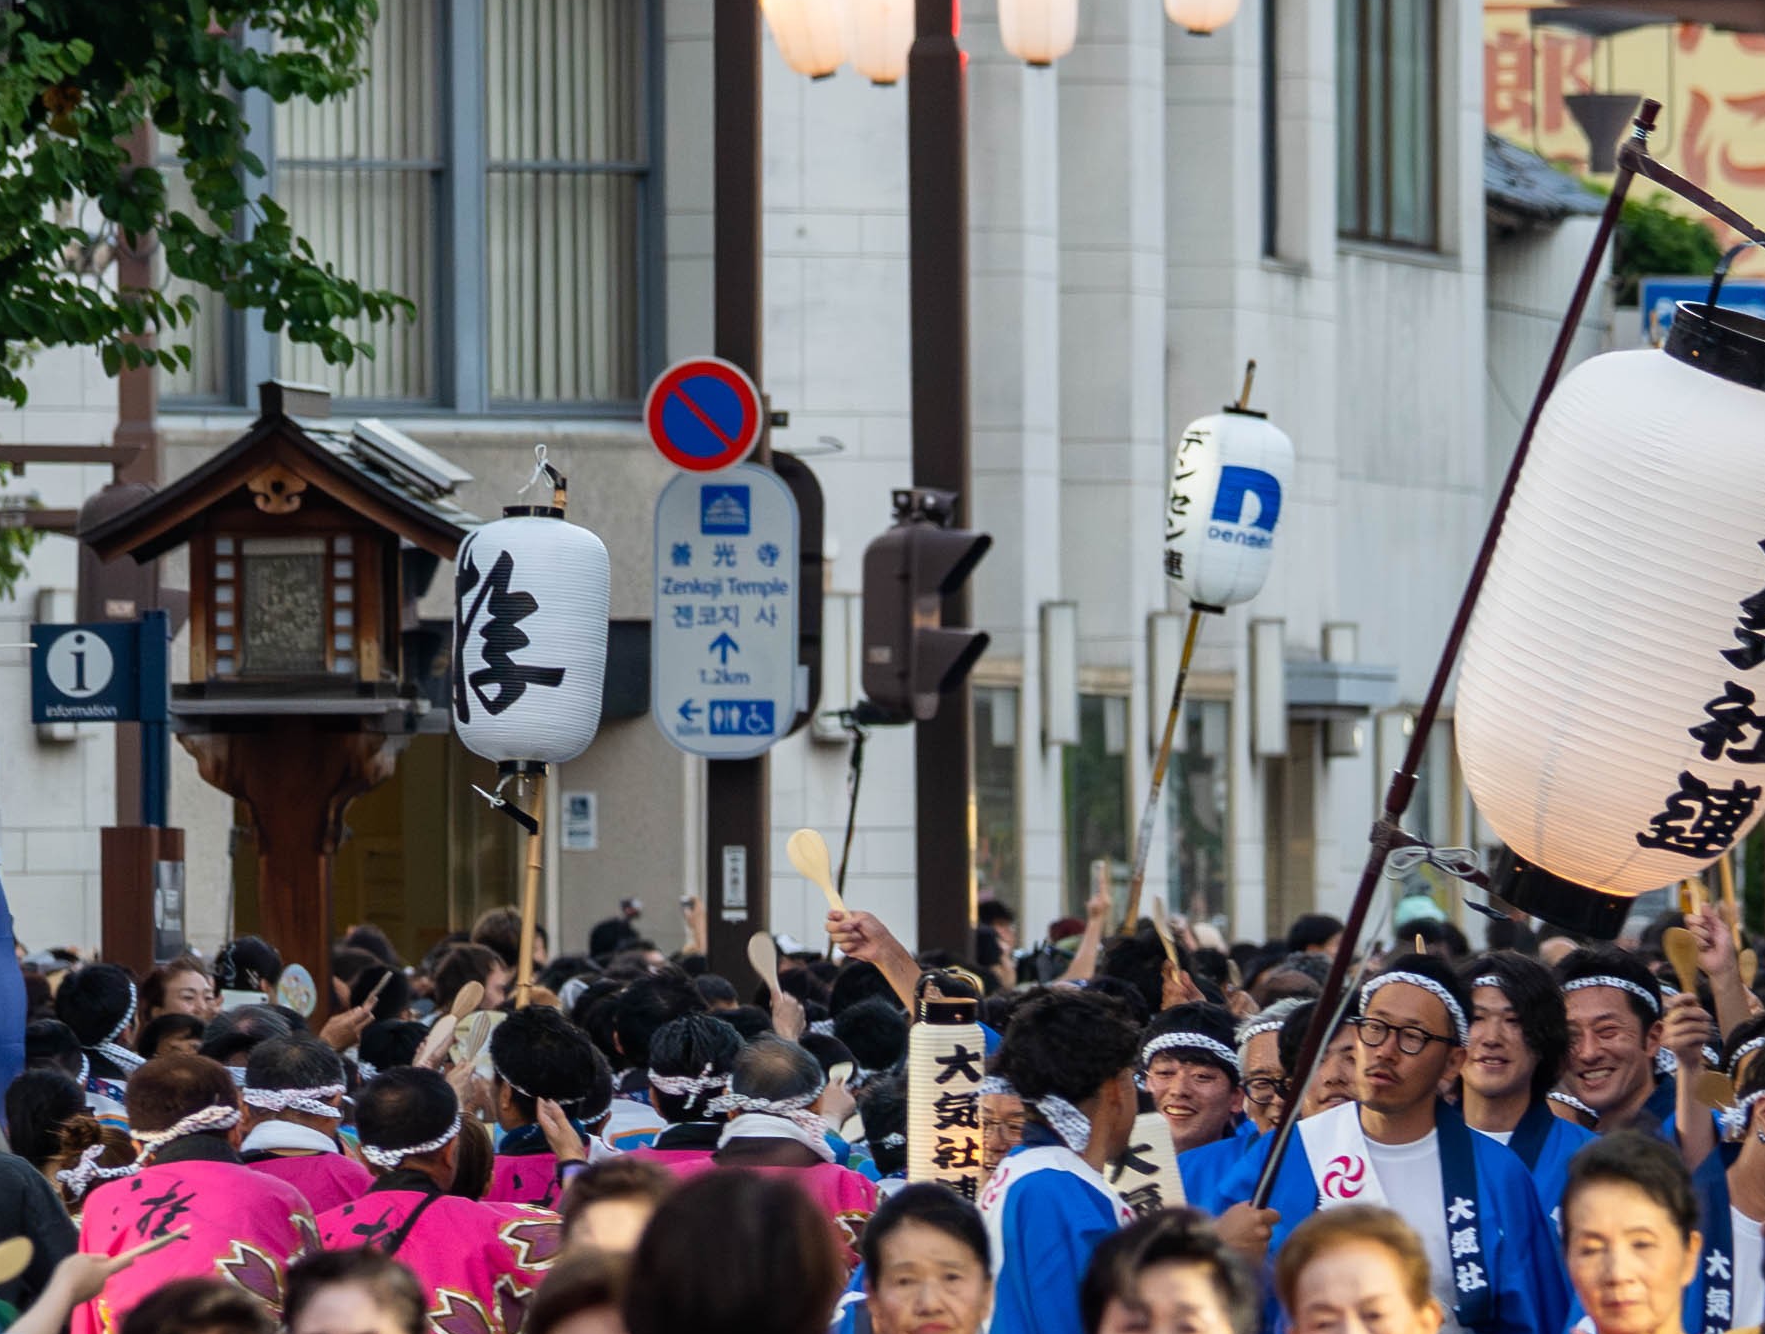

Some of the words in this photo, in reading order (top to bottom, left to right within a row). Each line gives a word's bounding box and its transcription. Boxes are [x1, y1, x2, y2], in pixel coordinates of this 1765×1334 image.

[671, 541, 781, 567] 善光寺
[661, 577, 723, 599] Zenkoji
[727, 577, 790, 599] Temple
[698, 669, 751, 685] 1.2km
[45, 704, 119, 718] information
[1447, 1196, 1489, 1294] 大気社
